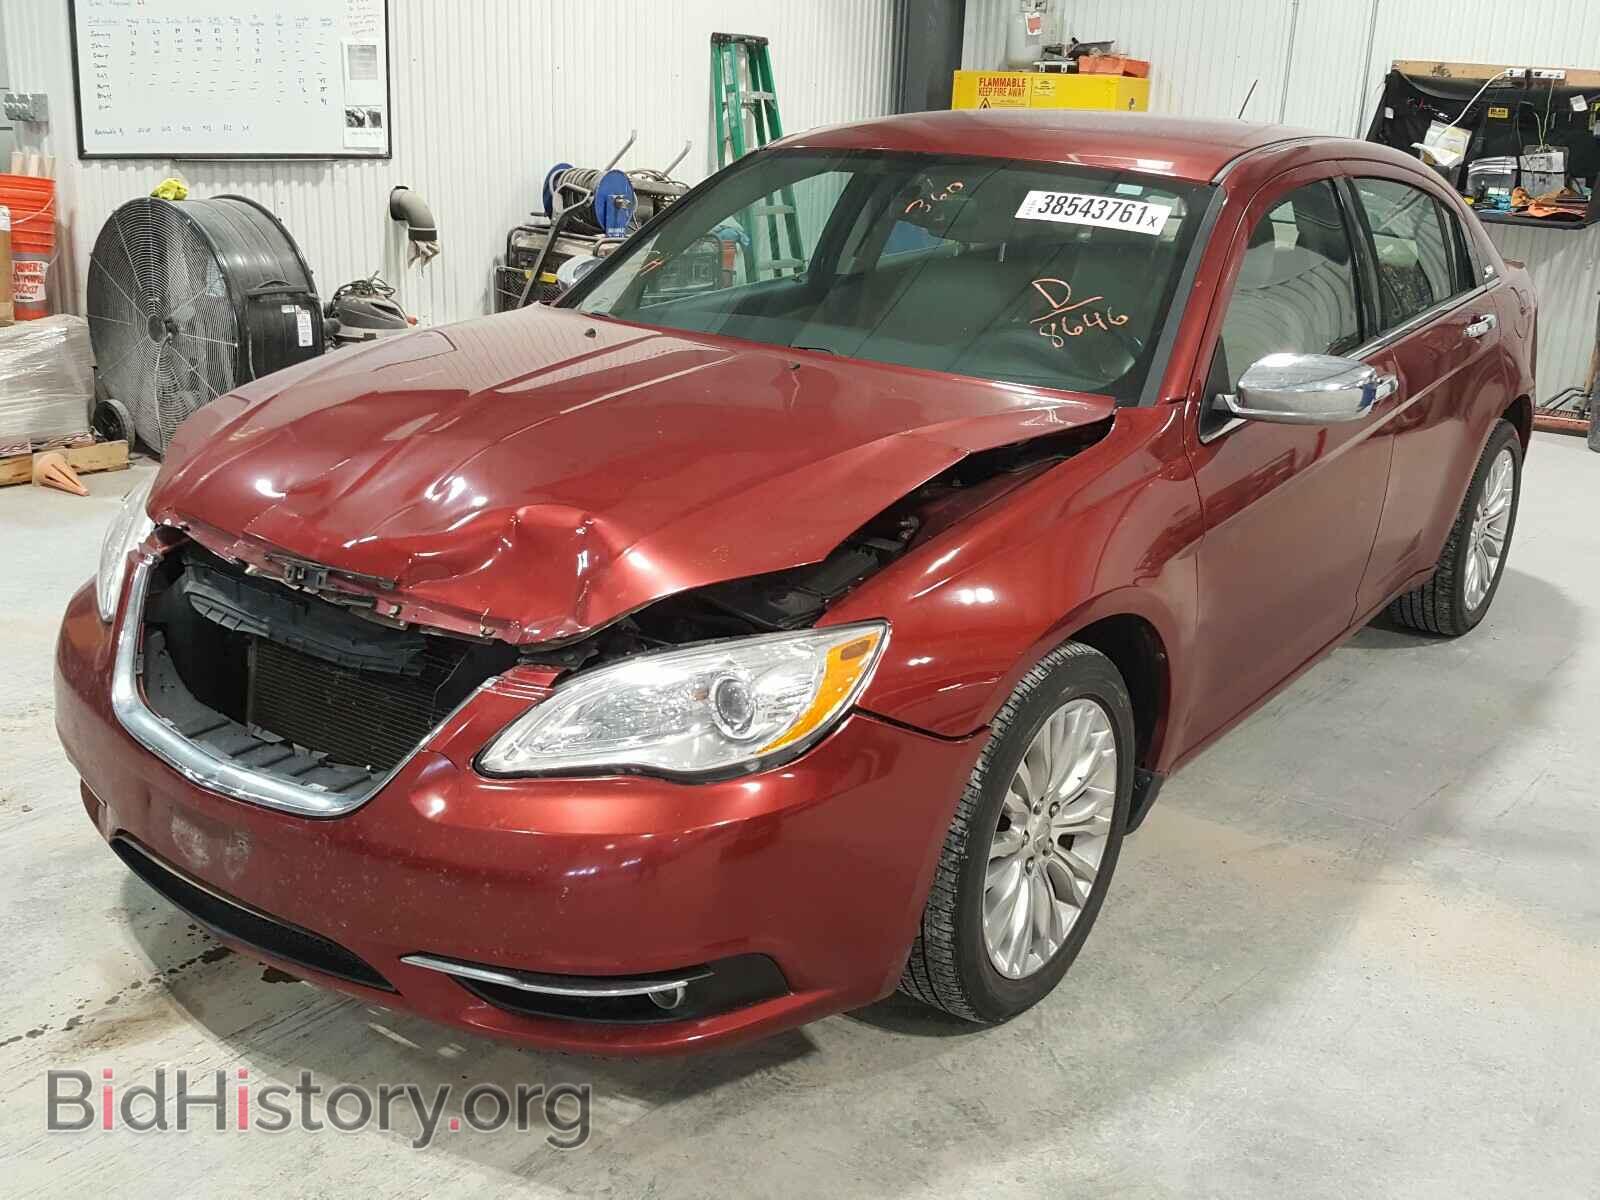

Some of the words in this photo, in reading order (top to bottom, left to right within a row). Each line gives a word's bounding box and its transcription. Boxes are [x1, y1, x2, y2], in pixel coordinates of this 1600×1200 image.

[978, 77, 1027, 88] FLAMMABLE
[978, 87, 993, 97] KEEP
[993, 88, 1007, 97] FIRE
[1008, 88, 1026, 97] AWAY
[1037, 194, 1149, 225] 38543761
[1039, 306, 1129, 348] 8646
